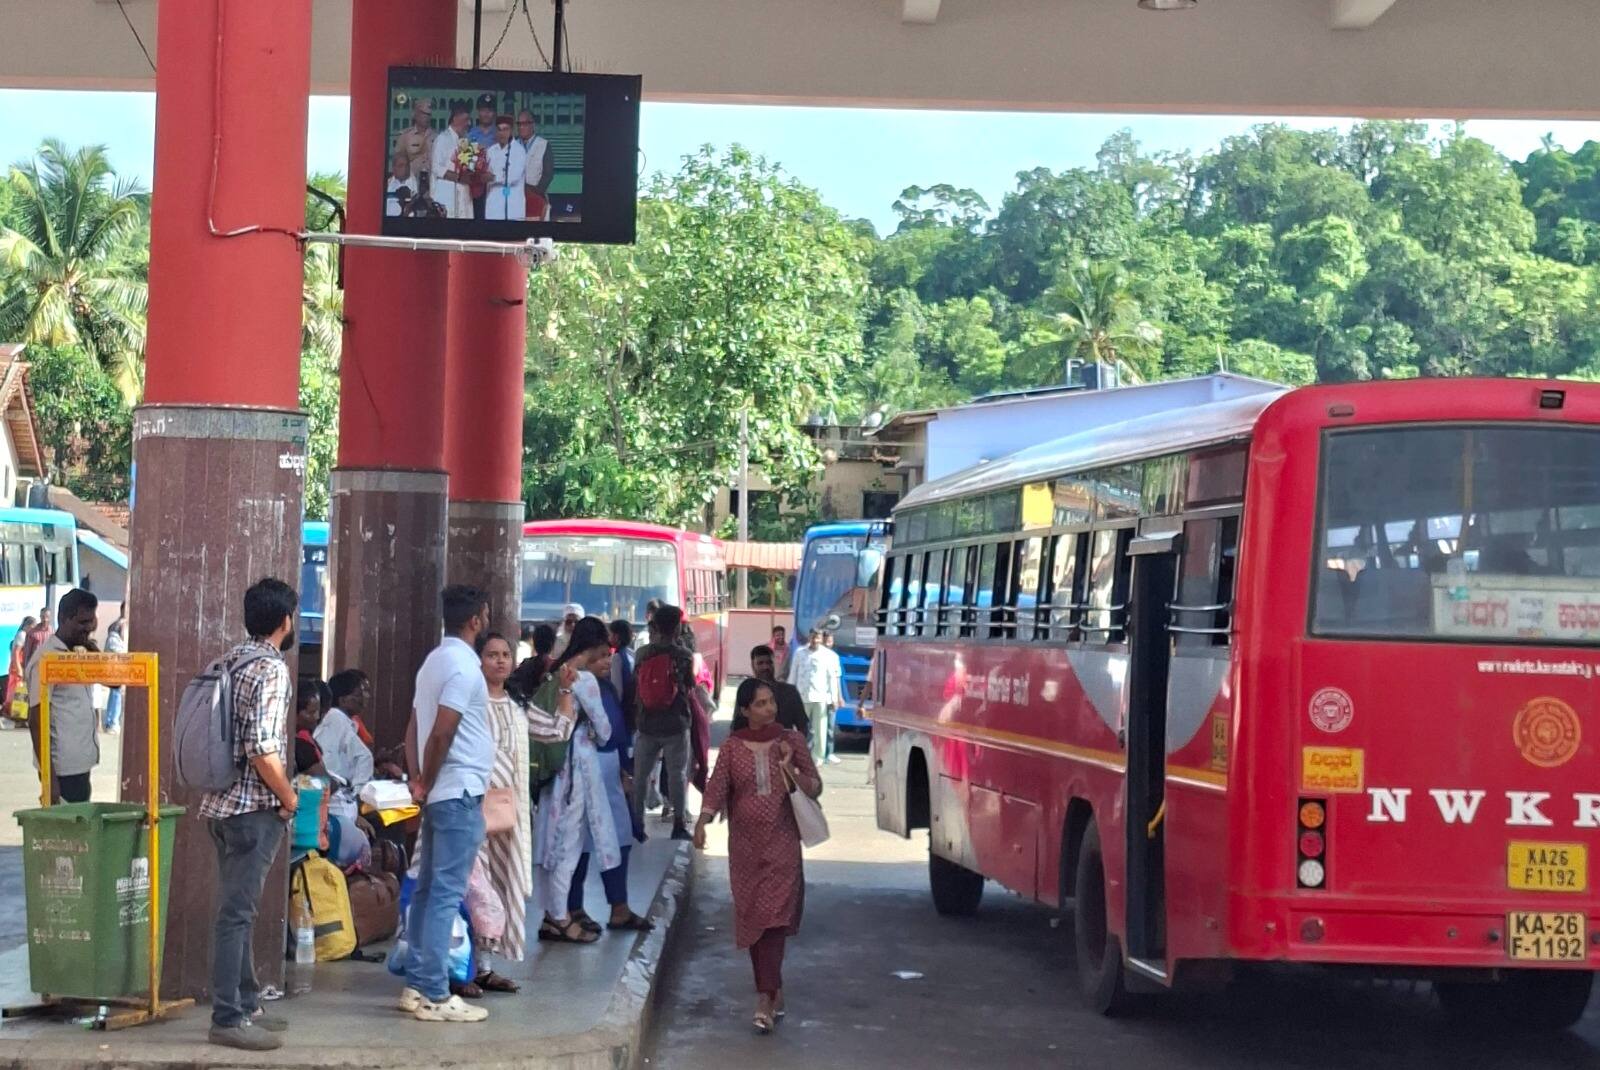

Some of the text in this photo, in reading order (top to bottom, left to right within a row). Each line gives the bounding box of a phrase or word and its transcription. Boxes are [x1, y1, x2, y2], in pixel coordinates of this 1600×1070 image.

[1528, 849, 1569, 866] KA26
[1524, 868, 1576, 886] F1192
[1515, 914, 1579, 935] KA-26
[1511, 937, 1582, 958] F-1192
